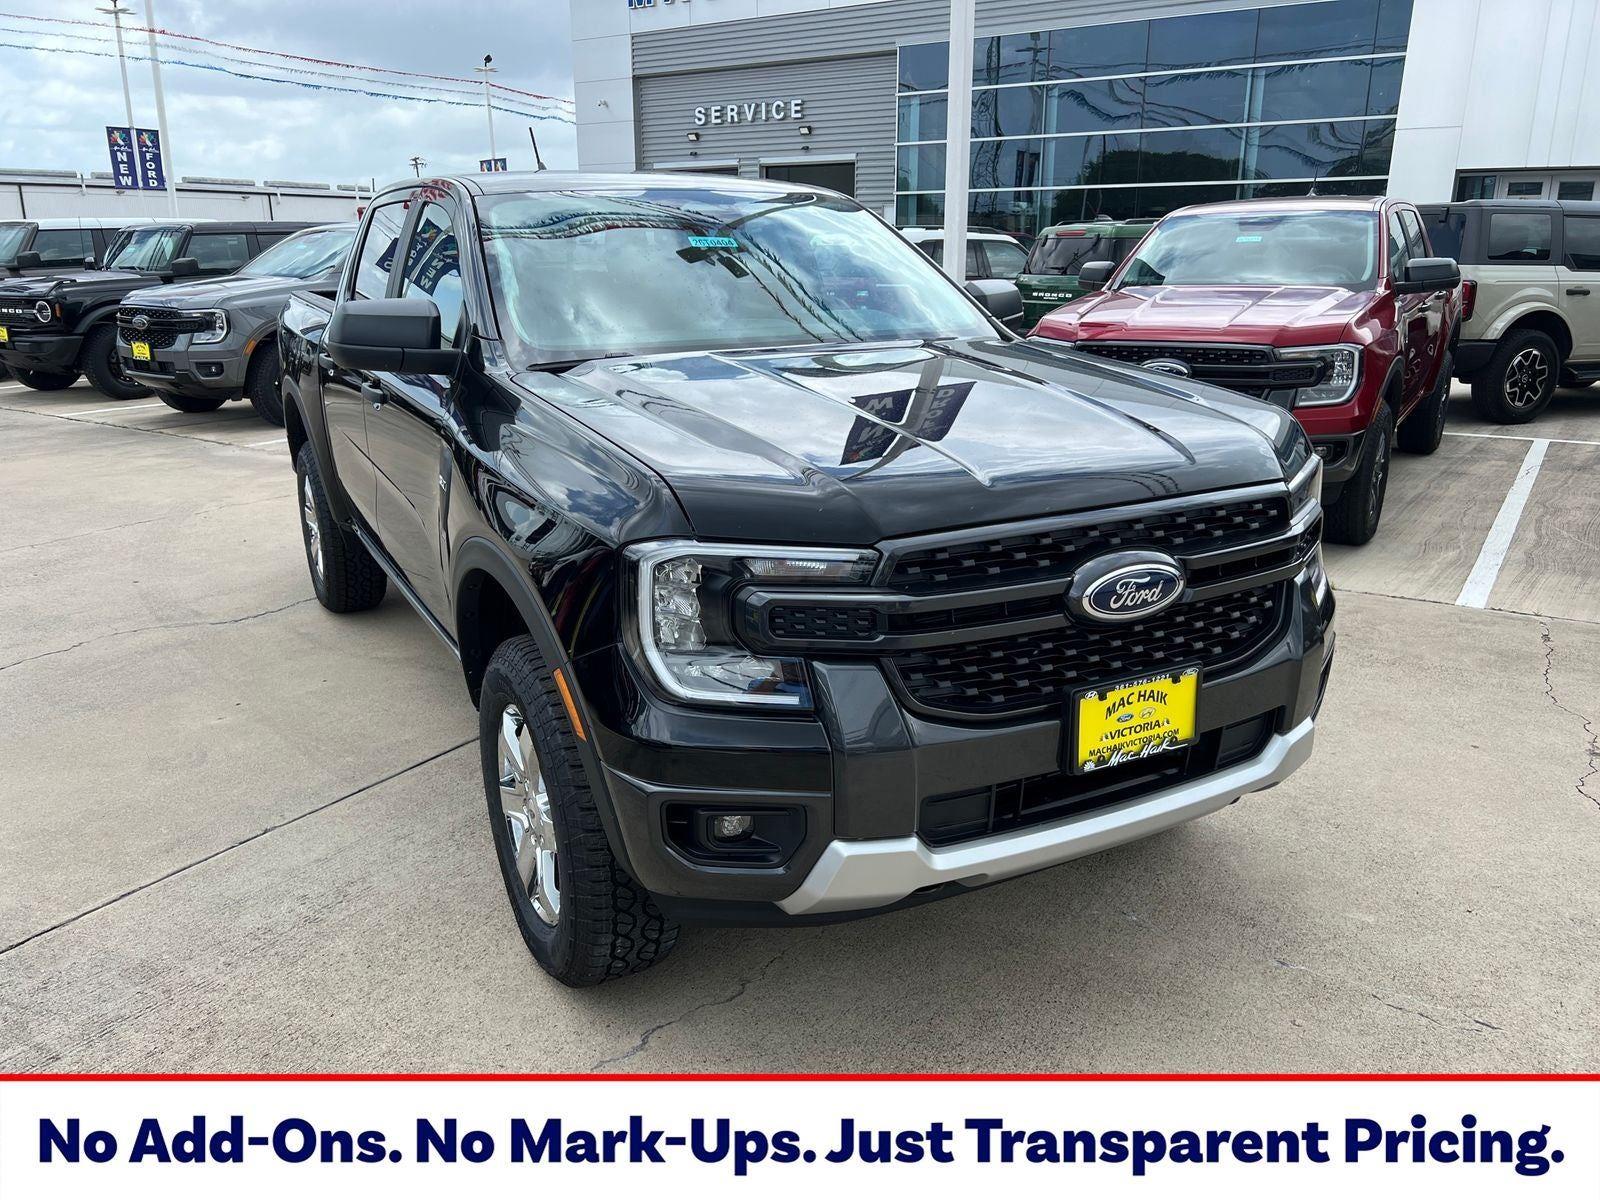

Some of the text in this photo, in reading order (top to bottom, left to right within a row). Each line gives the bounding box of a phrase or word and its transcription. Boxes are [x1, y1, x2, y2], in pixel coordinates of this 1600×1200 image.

[694, 99, 803, 126] SERVICE
[116, 151, 132, 186] NEW
[146, 152, 158, 187] FORD
[1109, 575, 1164, 609] Ford
[1105, 689, 1169, 720] MAC HAIK
[1088, 728, 1179, 757] MACHAIKVICTORIA.COM
[1109, 719, 1161, 740] VICTORIA
[1108, 738, 1188, 767] Mac Haik
